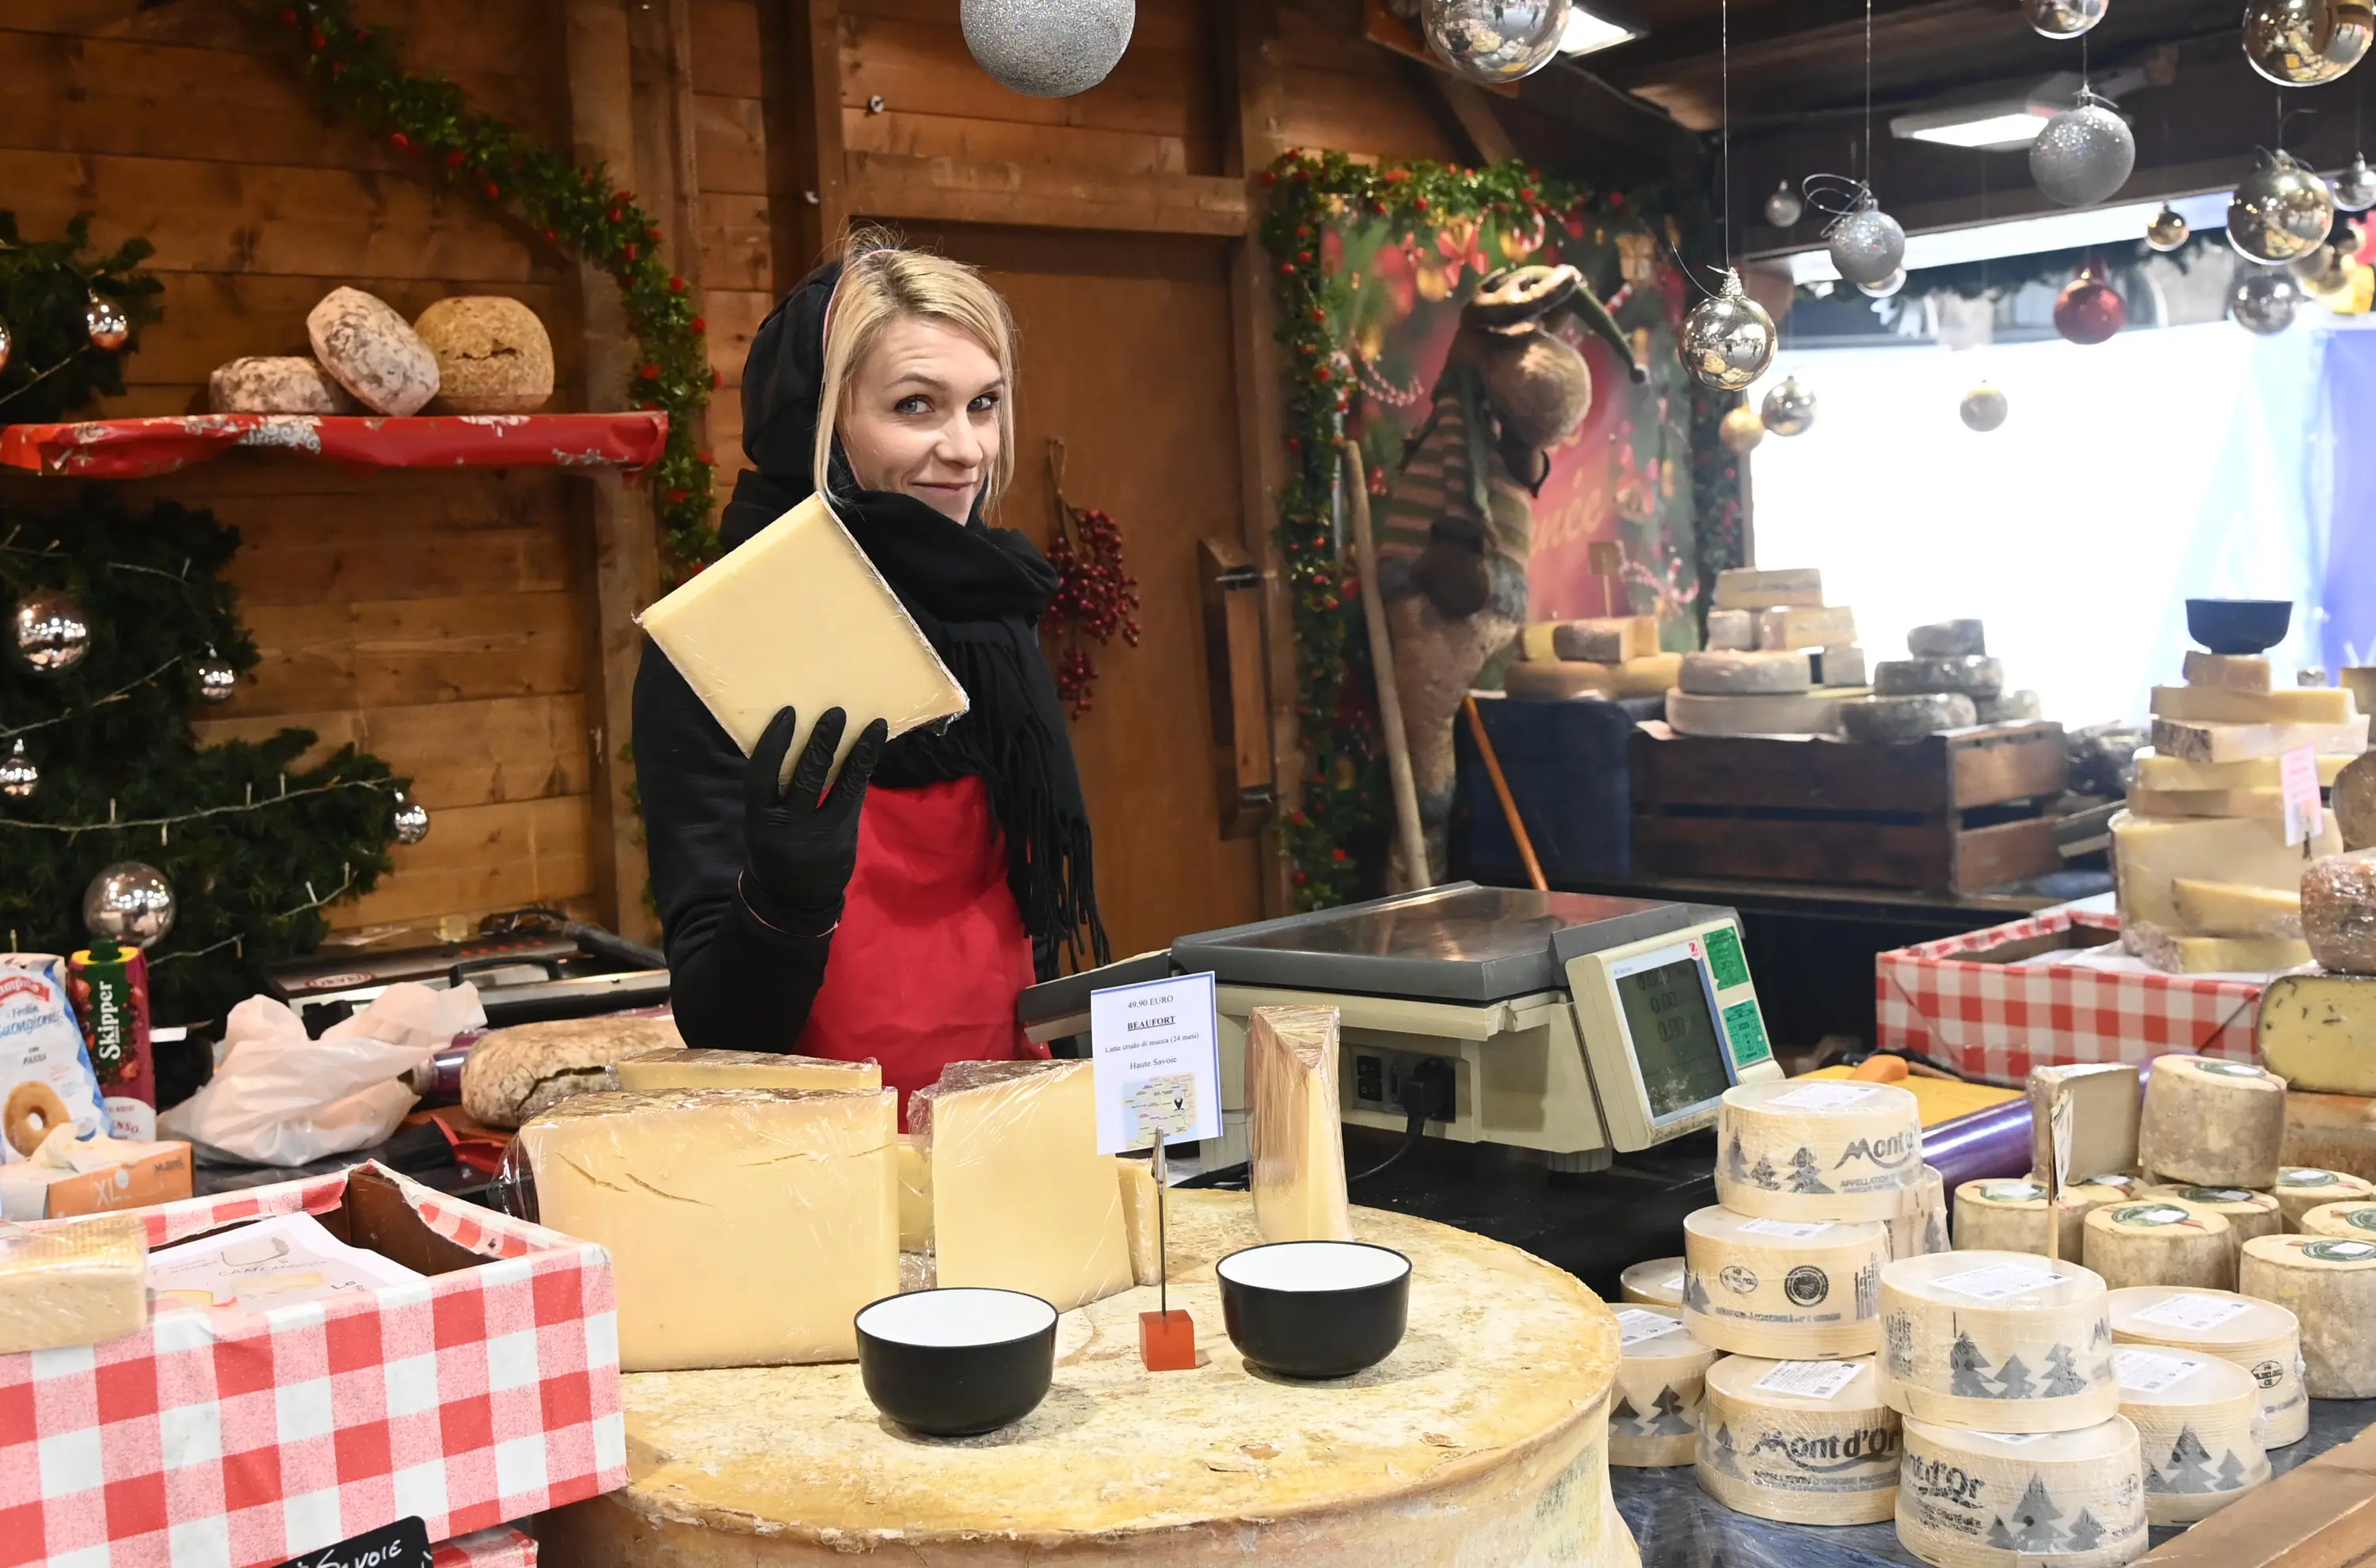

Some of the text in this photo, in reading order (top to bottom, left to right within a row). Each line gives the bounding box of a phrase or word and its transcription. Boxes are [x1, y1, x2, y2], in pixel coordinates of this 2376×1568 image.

[1128, 995, 1174, 1009] 49.90 EURO
[97, 980, 121, 1060] Skipper
[1127, 1015, 1175, 1031] BEAUFORT
[1171, 1035, 1180, 1044] (24
[1182, 1033, 1199, 1041] mesi)
[1129, 1056, 1177, 1070] Haute Savoie
[94, 1178, 121, 1207] XL
[1747, 1427, 1900, 1460] Mont d'Or
